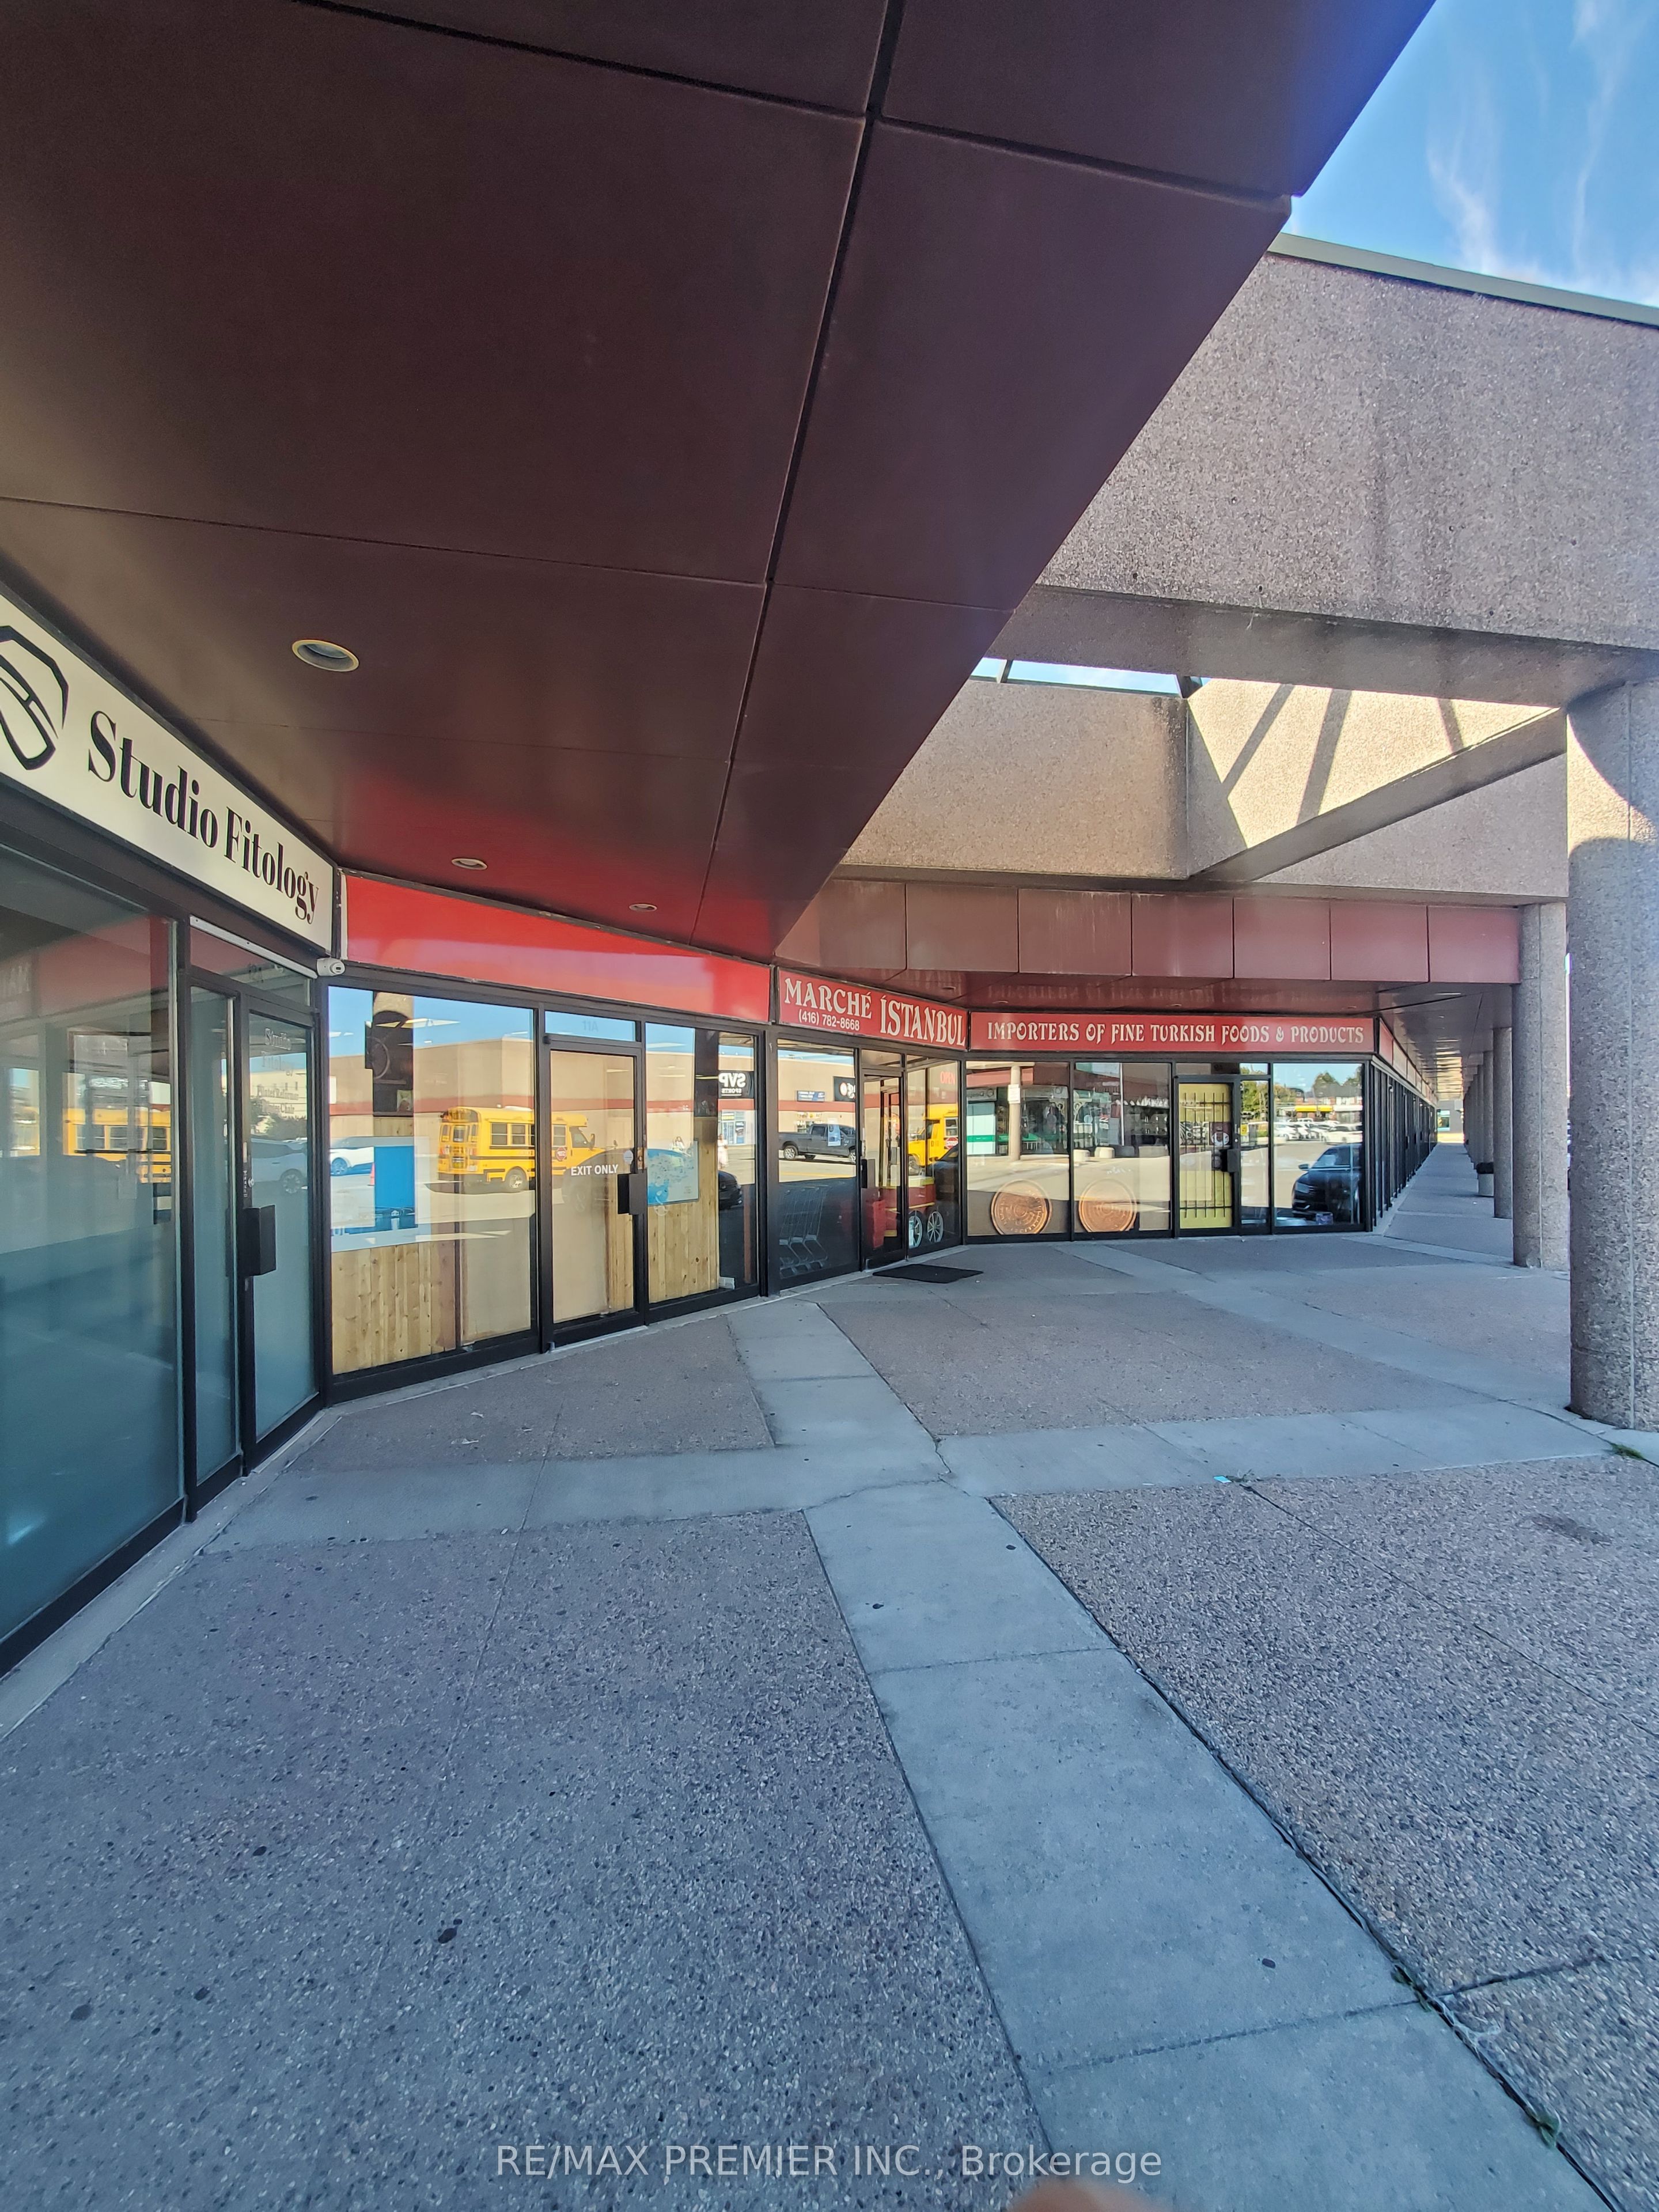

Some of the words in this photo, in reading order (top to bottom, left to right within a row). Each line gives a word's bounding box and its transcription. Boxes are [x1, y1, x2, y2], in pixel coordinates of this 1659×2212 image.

[88, 711, 218, 848] Studio
[224, 806, 319, 925] Fitology
[784, 978, 872, 1019] MARCHÉ
[798, 1009, 819, 1026] (416)
[822, 1013, 860, 1031] 782-8668
[987, 1022, 1080, 1041] IMPORTERS
[1085, 1023, 1105, 1044] OF
[1111, 1024, 1145, 1044] FINE
[1150, 1024, 1215, 1043] TURKISH
[1221, 1025, 1269, 1045] FOODS
[1275, 1026, 1284, 1043] &
[1290, 1026, 1364, 1044] PRODUCTS
[940, 1071, 956, 1085] OPEN
[571, 1166, 592, 1176] EXIT
[594, 1164, 618, 1175] ONLY
